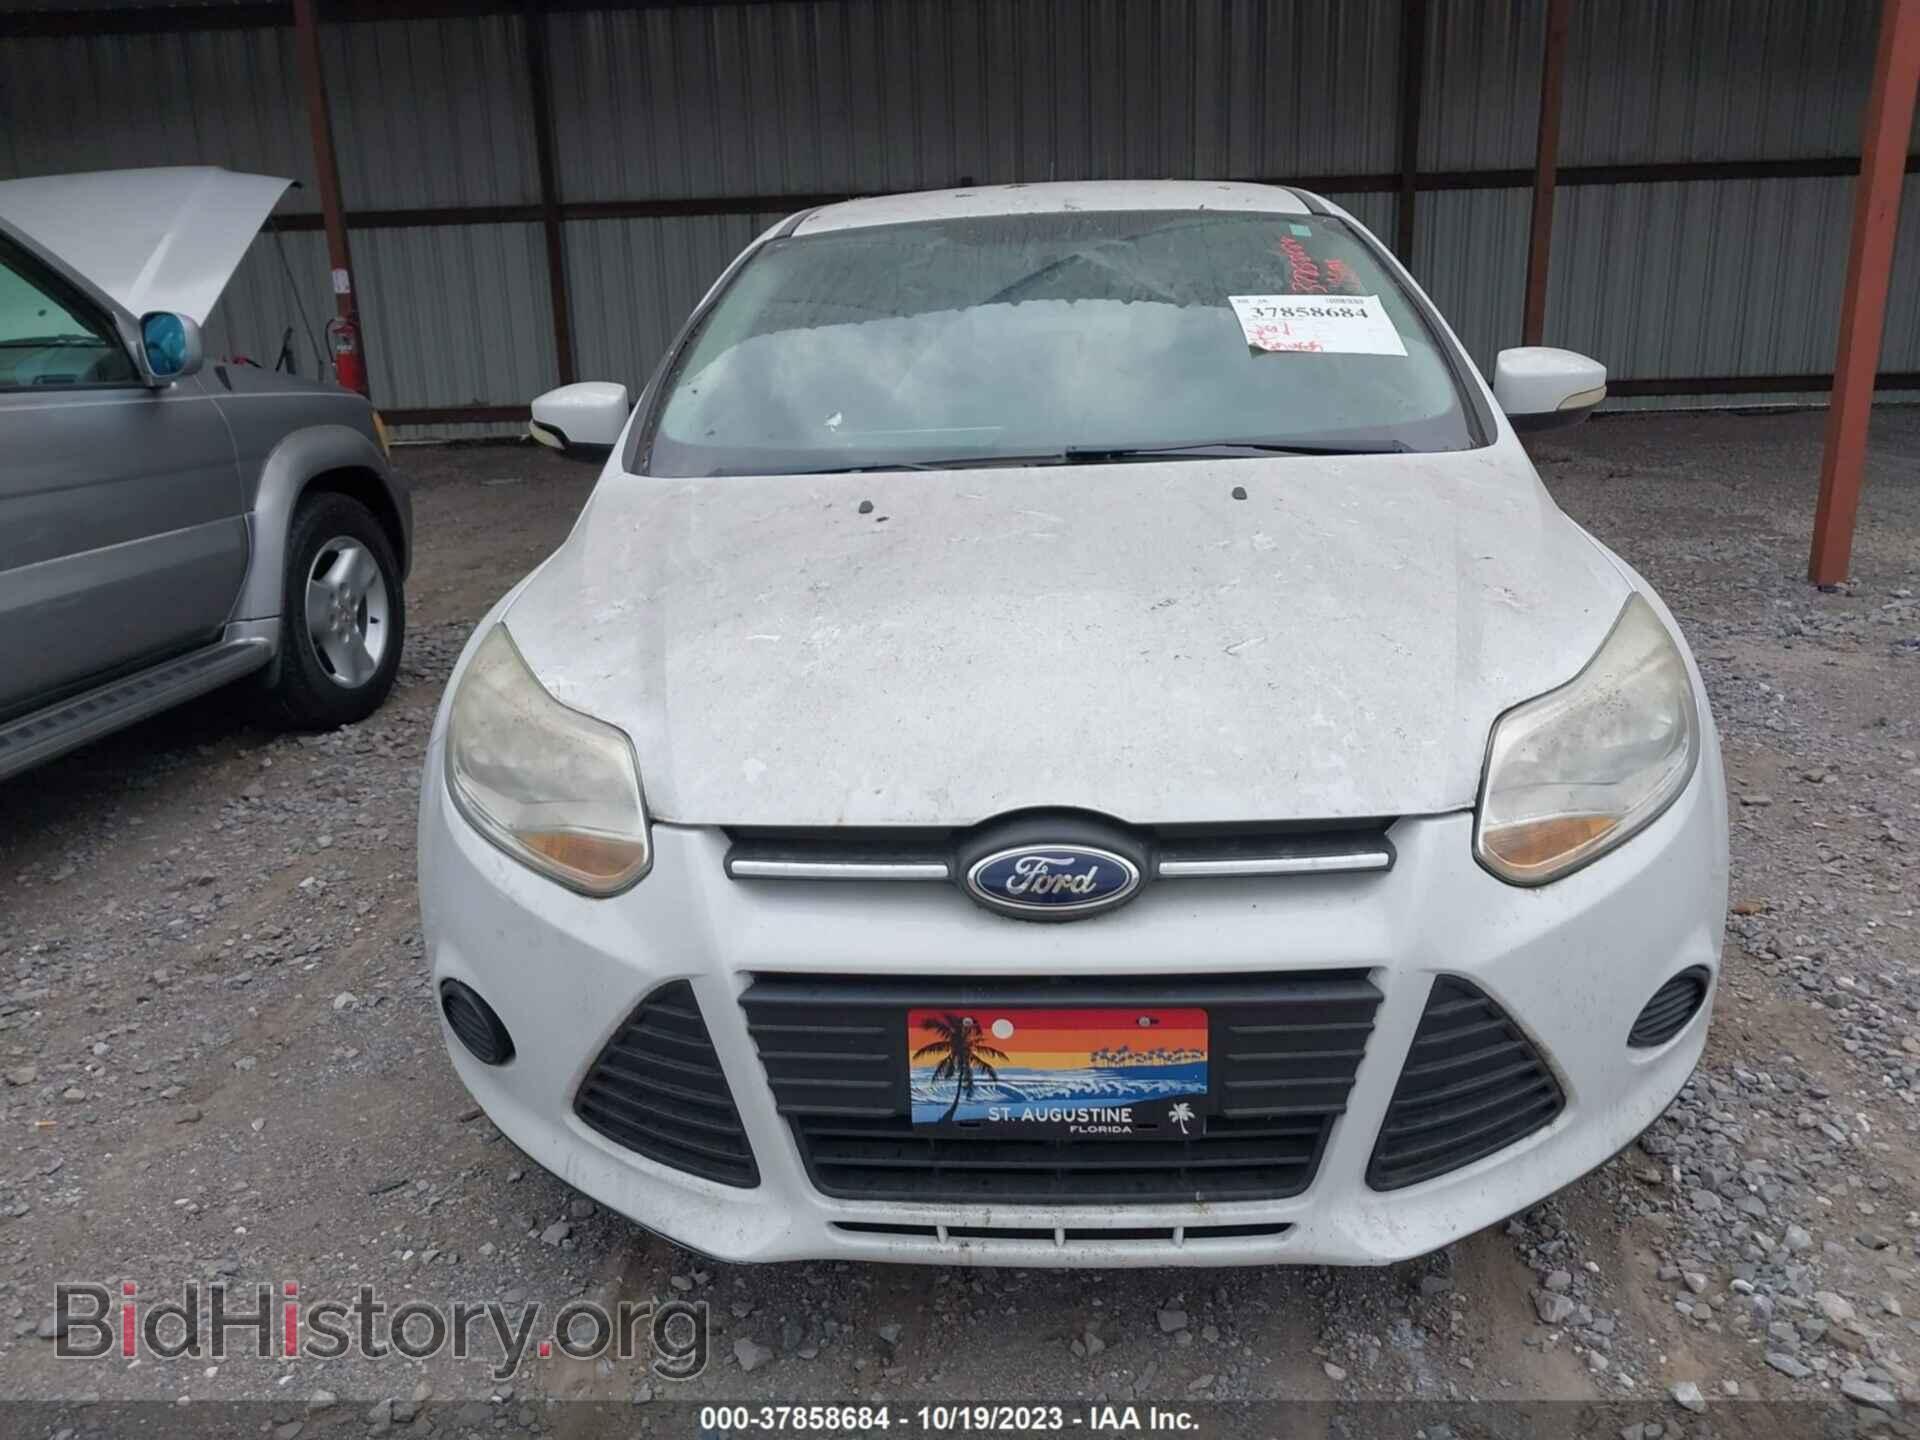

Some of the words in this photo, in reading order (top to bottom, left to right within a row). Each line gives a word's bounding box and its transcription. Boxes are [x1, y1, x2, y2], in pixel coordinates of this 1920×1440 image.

[1251, 307, 1368, 318] 37858684
[1006, 856, 1098, 894] Ford
[987, 1108, 1015, 1122] ST.
[1023, 1108, 1132, 1123] AUGUSTINE
[1070, 1125, 1132, 1134] FLORIDA
